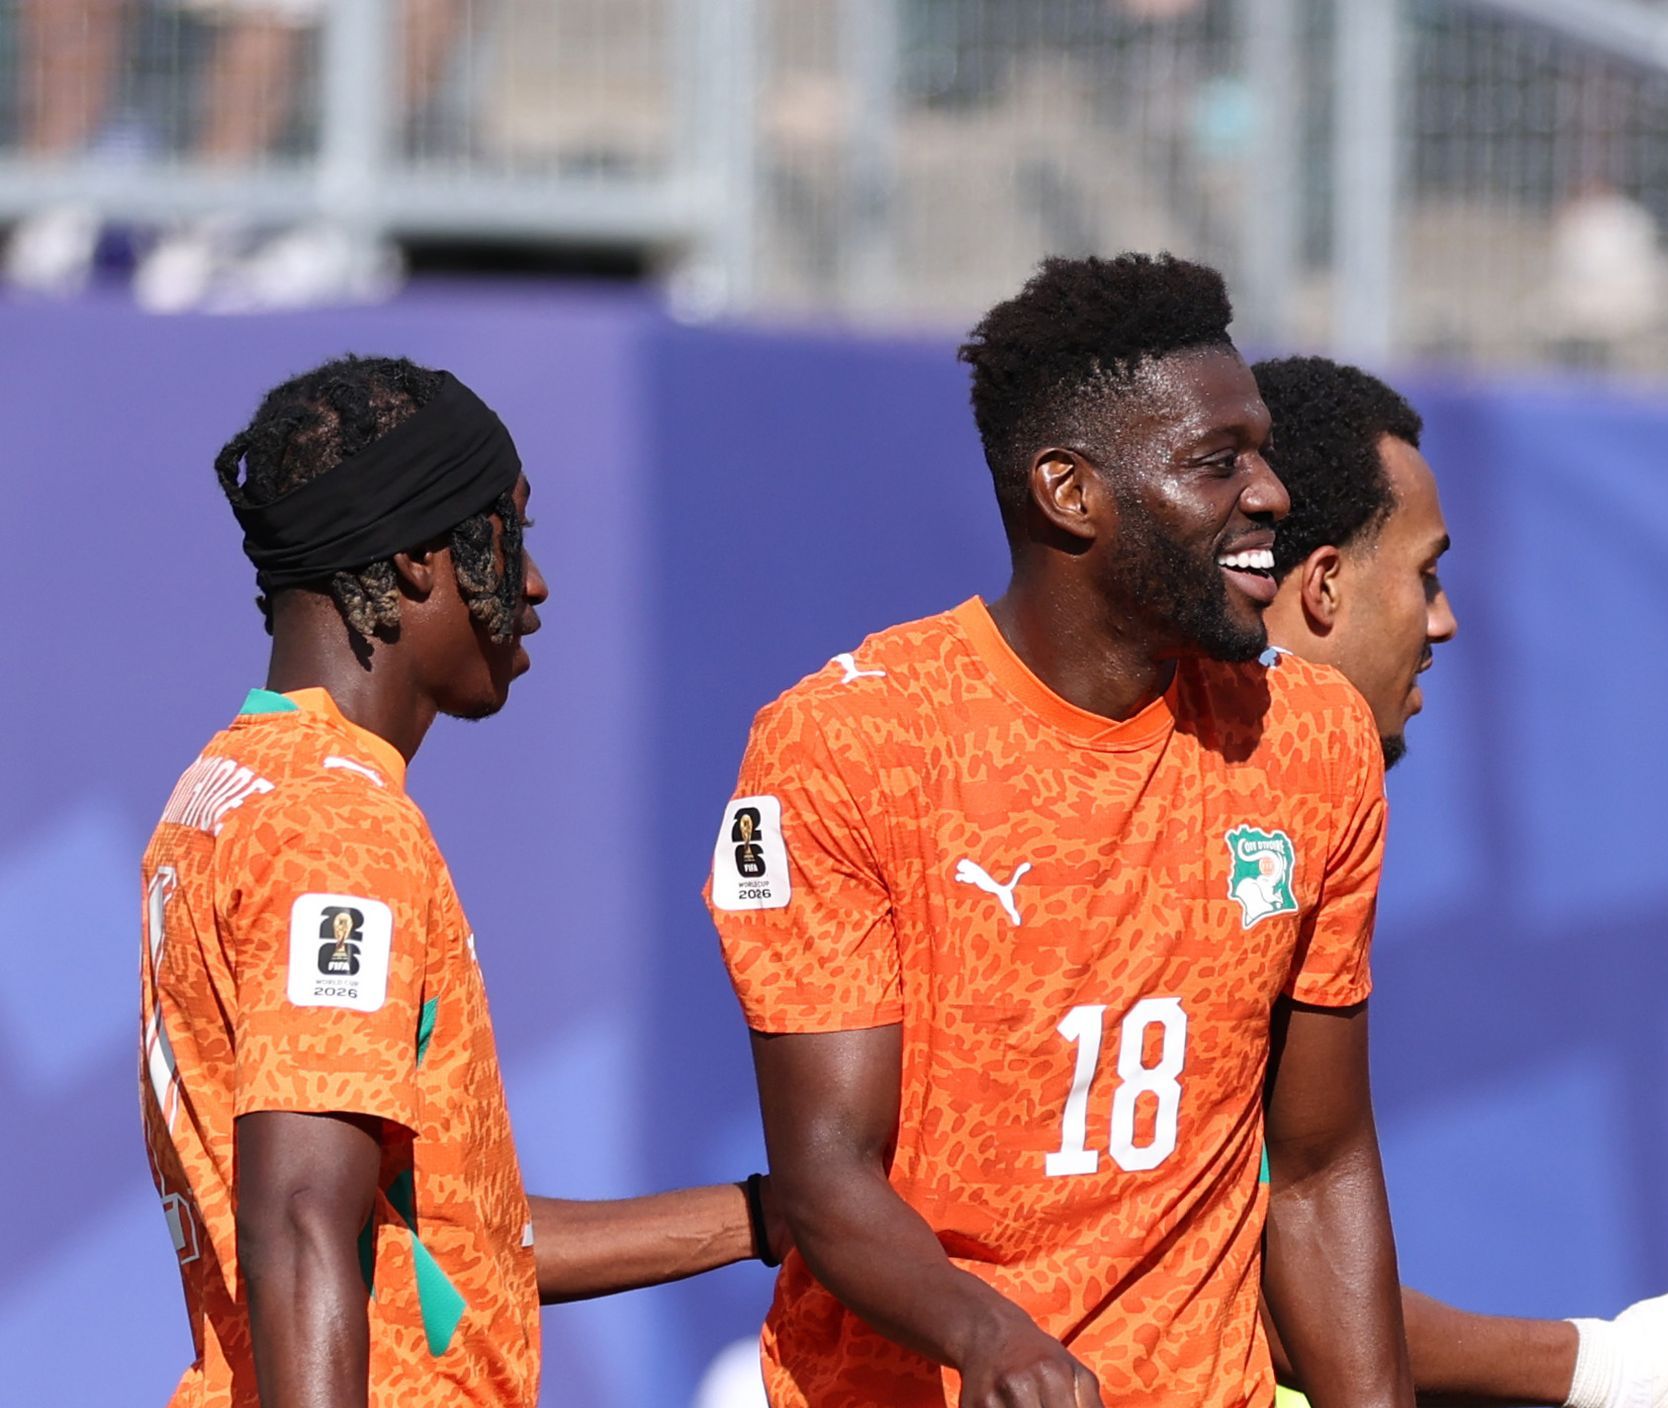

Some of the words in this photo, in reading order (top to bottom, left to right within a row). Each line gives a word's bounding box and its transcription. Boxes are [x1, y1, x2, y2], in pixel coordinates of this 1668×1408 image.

[743, 862, 759, 872] FIFA
[738, 888, 772, 900] 2026
[313, 987, 358, 999] 2026
[1045, 997, 1188, 1177] 18
